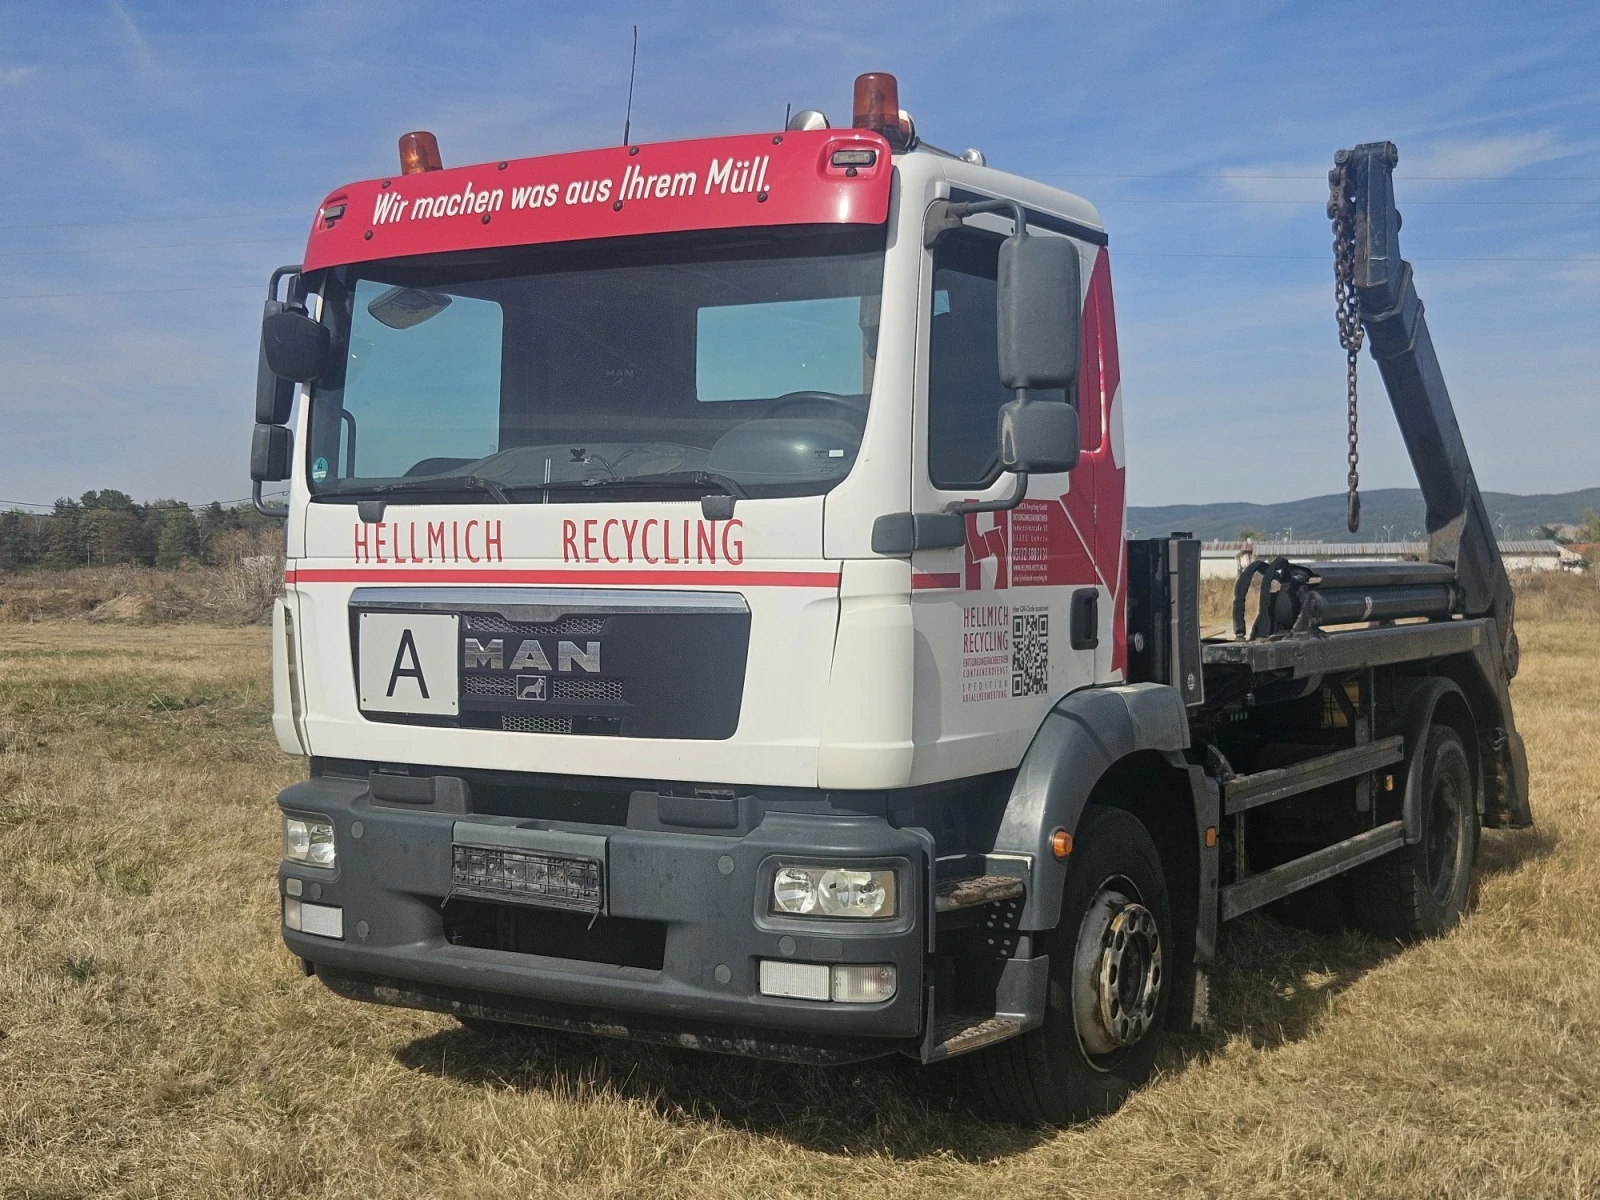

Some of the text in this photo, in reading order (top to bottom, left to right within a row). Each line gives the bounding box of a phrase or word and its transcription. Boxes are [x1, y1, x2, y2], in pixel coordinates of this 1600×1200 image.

[372, 156, 771, 226] Wir machen was aus Ihrem Müll.
[354, 518, 744, 566] HELLMICH RECYCLING
[963, 605, 1009, 628] HELLMICH
[463, 637, 601, 672] MAN
[963, 630, 1009, 653] RECYCLING
[386, 629, 430, 699] A
